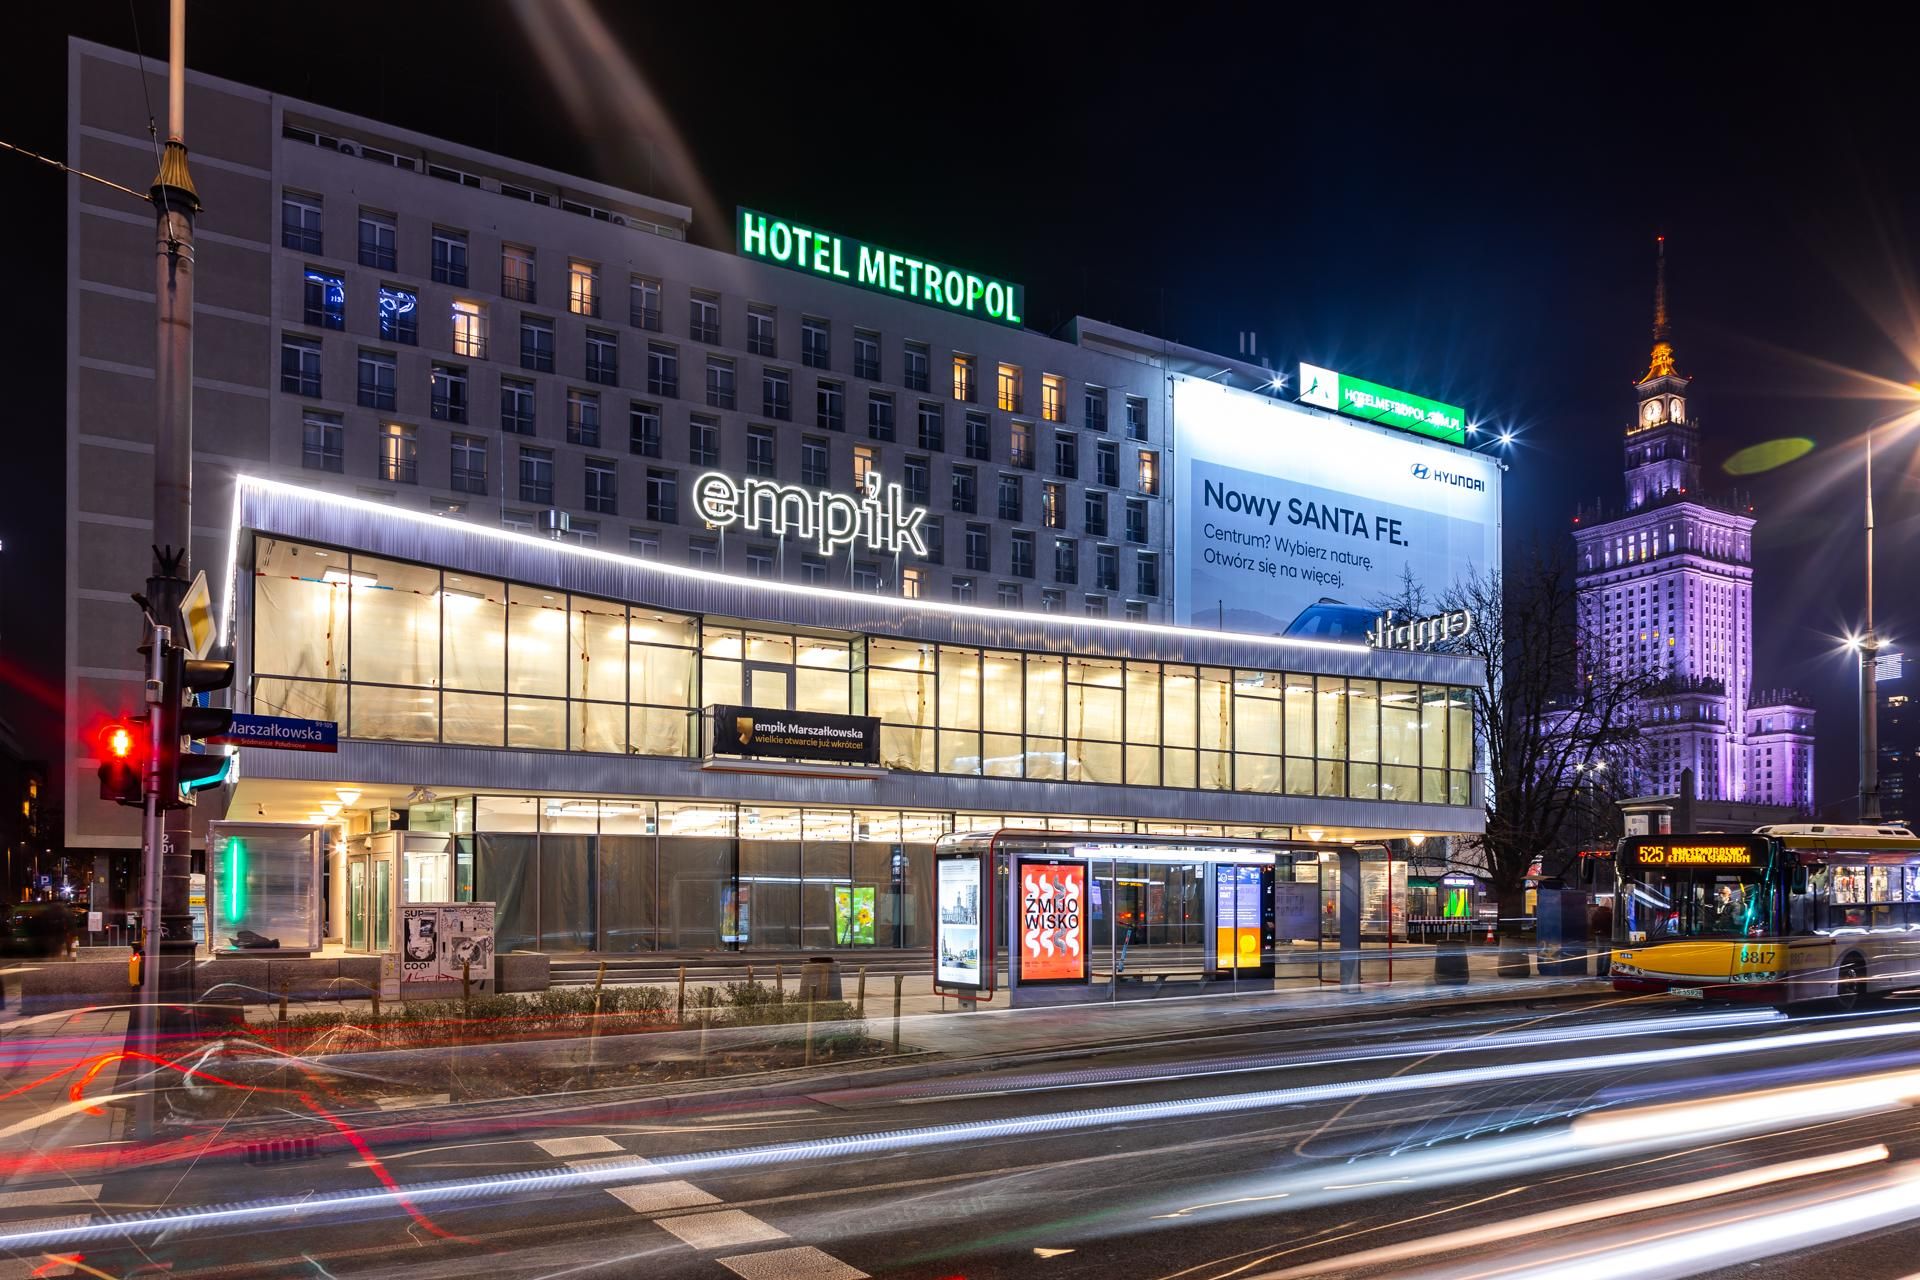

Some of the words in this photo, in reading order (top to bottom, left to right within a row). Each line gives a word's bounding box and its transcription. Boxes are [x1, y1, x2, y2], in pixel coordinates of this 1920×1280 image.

[744, 212, 850, 278] HOTEL
[858, 245, 1021, 323] METROPOL
[1434, 469, 1485, 493] HYUNDAI
[692, 472, 928, 556] empik
[1204, 479, 1281, 526] Nowy
[1287, 498, 1370, 539] SANTA
[1376, 516, 1409, 547] FE.
[1203, 523, 1271, 549] Centrum?
[1274, 536, 1327, 560] Wybierz
[1330, 550, 1373, 571] naturę.
[1203, 548, 1254, 571] Otwórz
[1258, 557, 1276, 578] się
[1280, 564, 1297, 578] na
[1301, 566, 1345, 589] więcej.
[228, 721, 322, 741] Marszałkowska
[754, 721, 787, 735] empik
[788, 724, 863, 739] Marszałkowska
[755, 735, 784, 745] wielkie
[784, 738, 818, 747] otwarcie
[818, 740, 830, 749] już
[831, 741, 864, 750] wkrótce!
[1639, 846, 1665, 863] 525
[1026, 894, 1078, 914] ŻMIJO
[1025, 914, 1079, 930] WISKO
[1741, 951, 1776, 965] 8817
